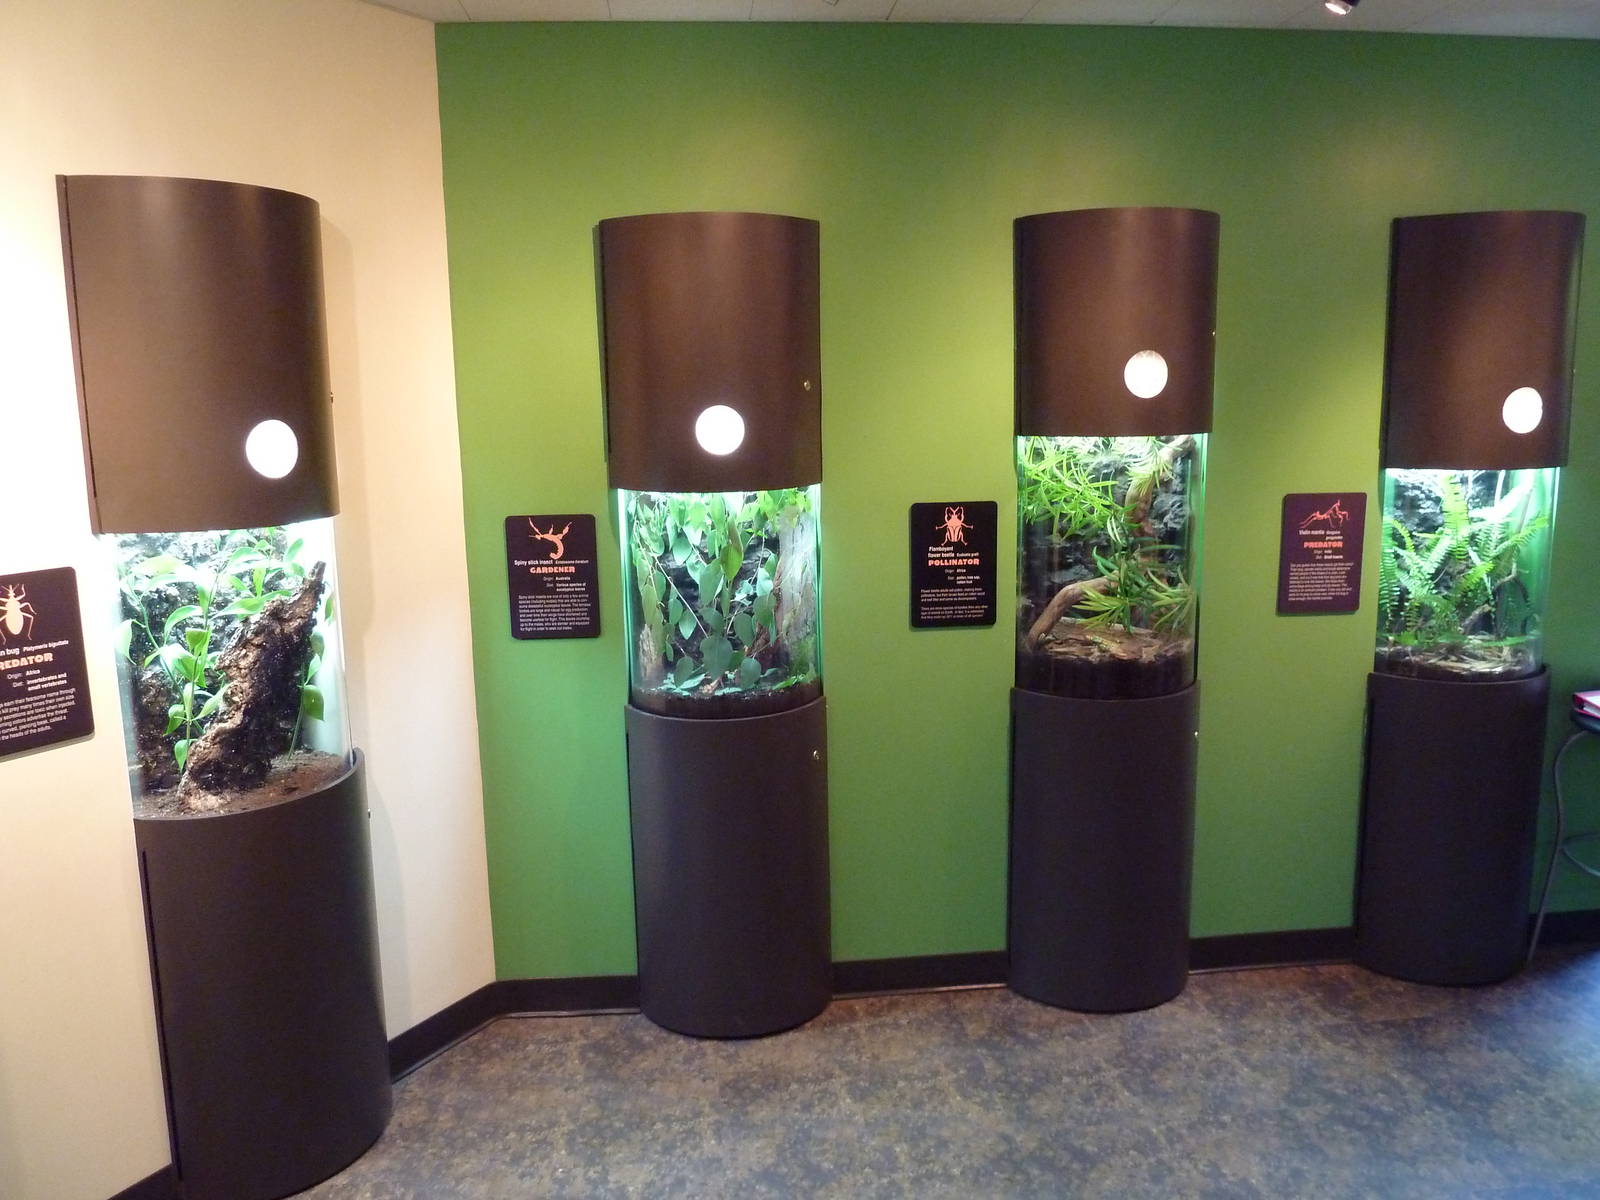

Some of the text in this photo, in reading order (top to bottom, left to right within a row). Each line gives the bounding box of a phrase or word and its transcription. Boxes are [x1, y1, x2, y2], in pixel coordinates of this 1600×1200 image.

[928, 558, 980, 566] POLLINATOR
[529, 566, 575, 574] GARDENER
[6, 648, 20, 656] bug
